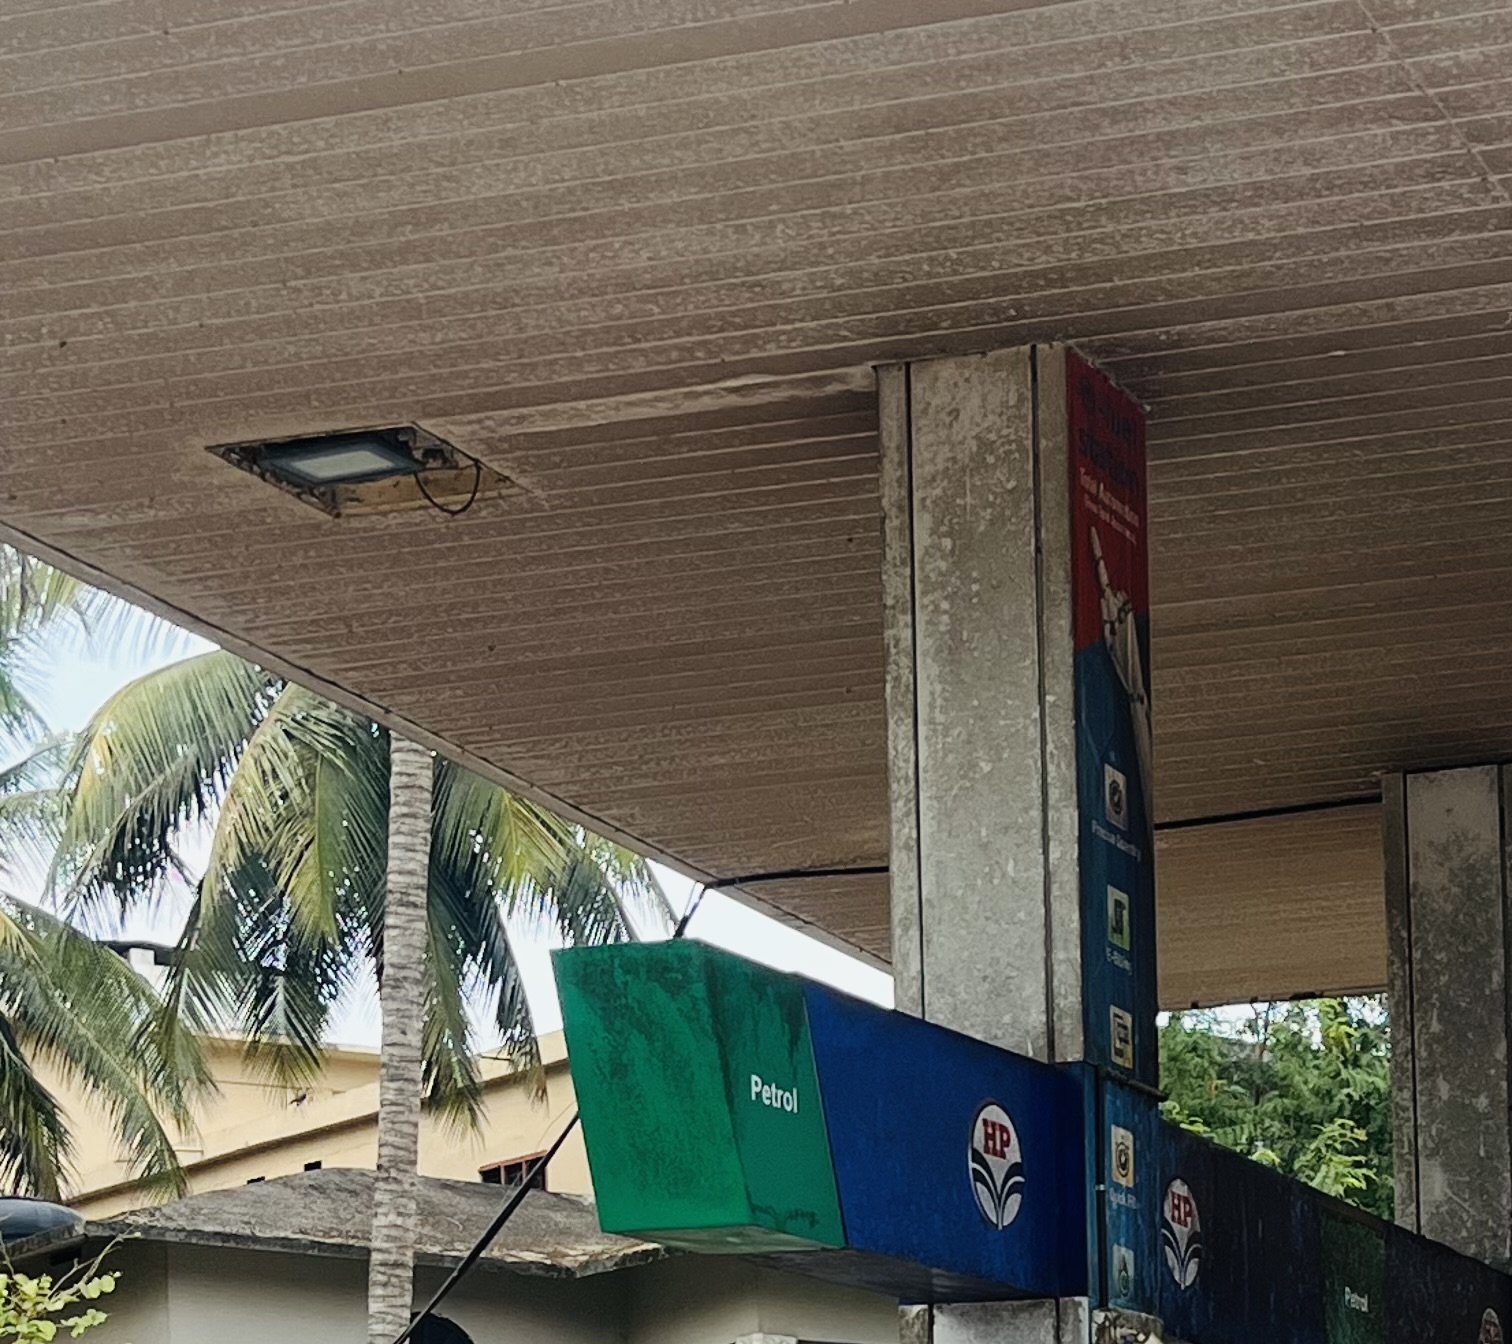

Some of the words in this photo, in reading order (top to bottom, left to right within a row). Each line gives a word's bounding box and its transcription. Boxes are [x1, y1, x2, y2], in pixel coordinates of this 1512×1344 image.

[751, 1074, 798, 1114] Petrol
[982, 1118, 1011, 1160] HP
[1171, 1190, 1193, 1228] HP
